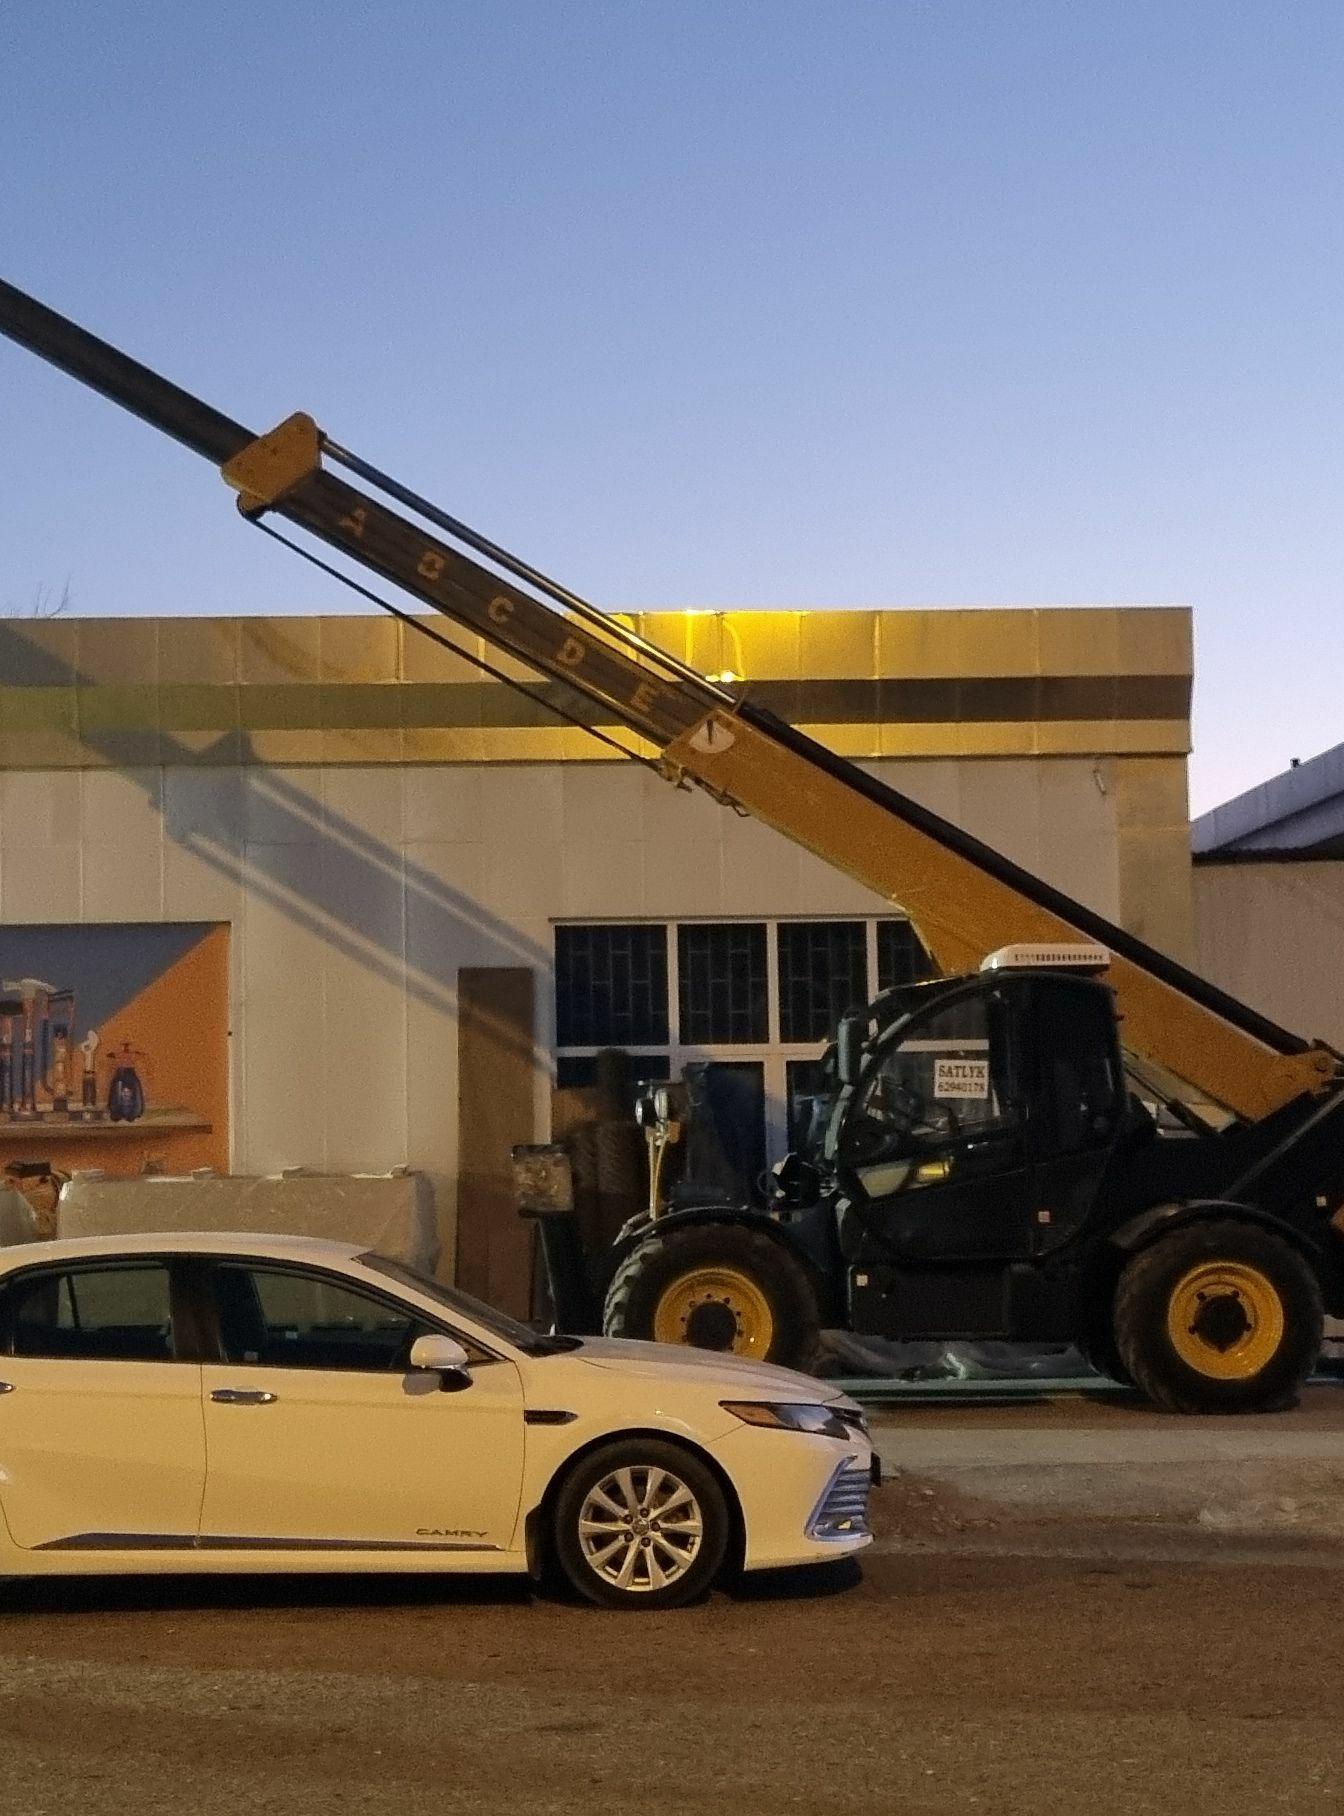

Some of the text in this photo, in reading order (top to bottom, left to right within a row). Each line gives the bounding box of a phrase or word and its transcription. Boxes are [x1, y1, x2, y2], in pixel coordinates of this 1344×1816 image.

[487, 596, 515, 624] C
[558, 637, 587, 666] D
[415, 1527, 489, 1538] CAMRY
